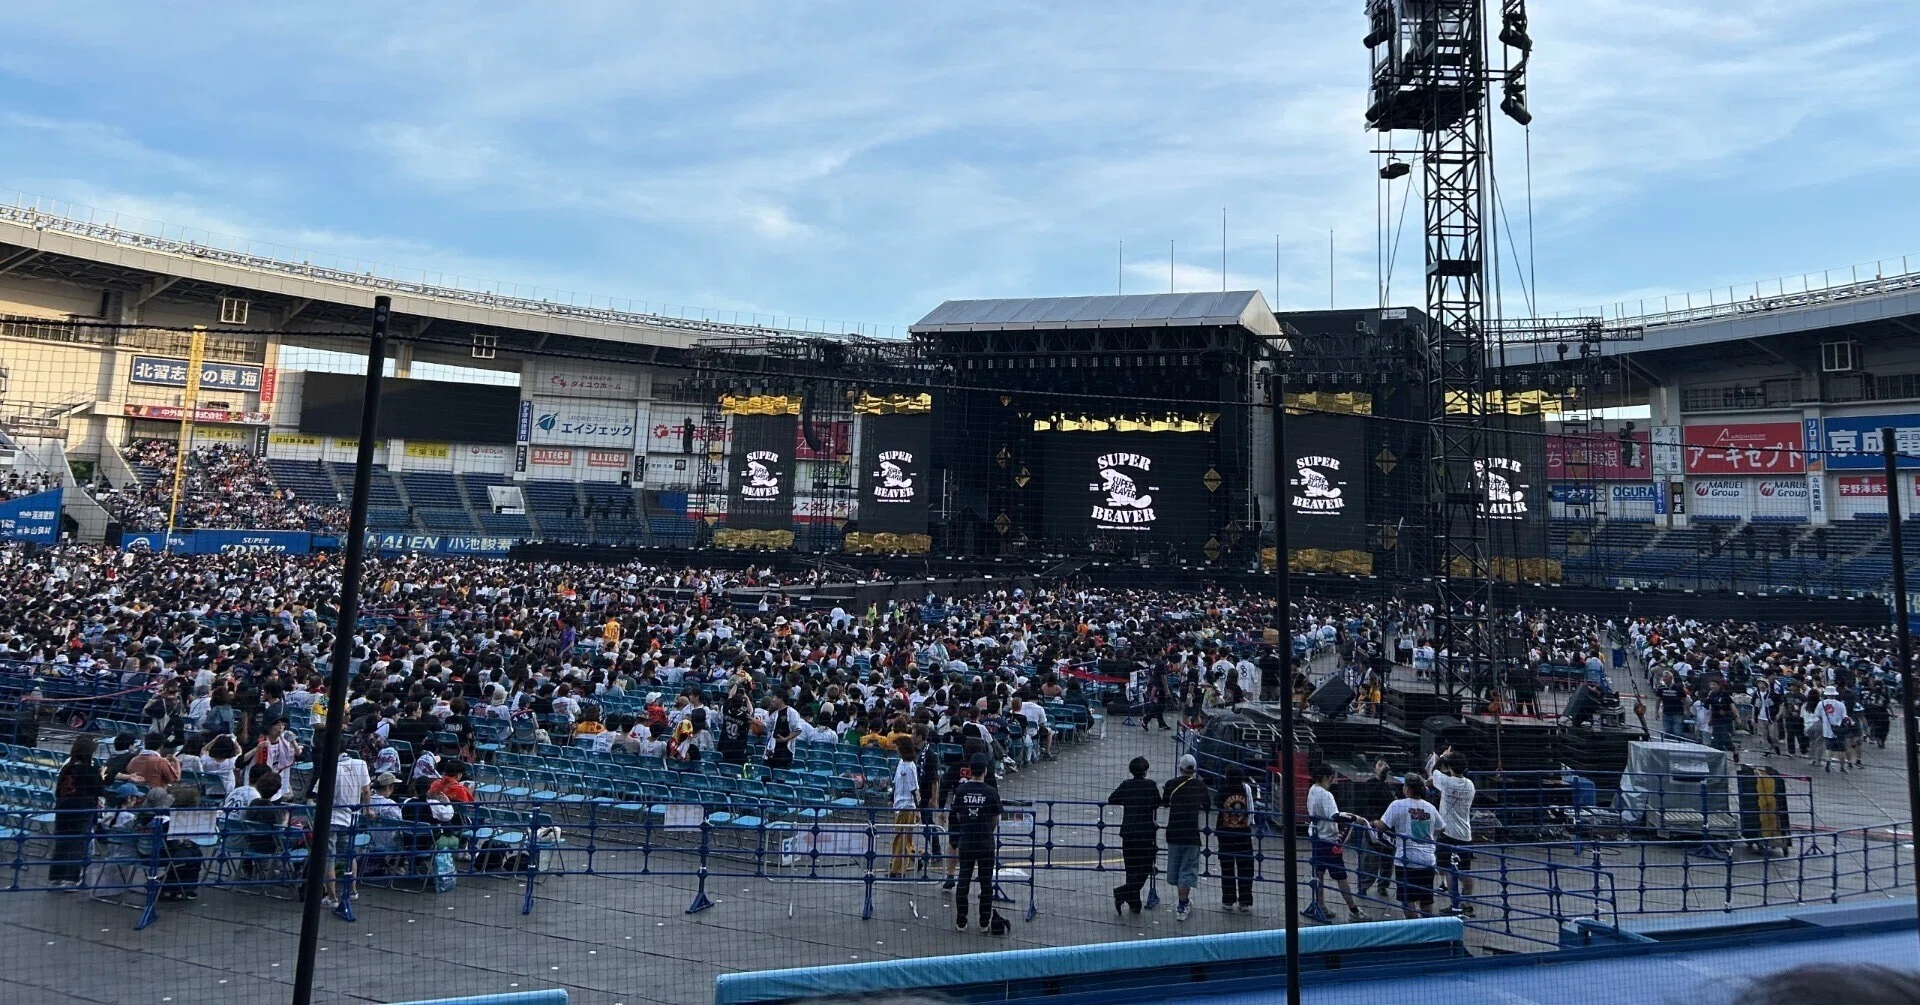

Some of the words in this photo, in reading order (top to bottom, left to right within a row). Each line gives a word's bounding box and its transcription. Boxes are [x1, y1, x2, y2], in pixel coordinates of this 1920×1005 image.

[136, 362, 258, 387] 北習志の東海
[561, 423, 632, 436] エイジェック
[746, 451, 779, 462] SUPER
[878, 451, 913, 463] SUPER
[1097, 452, 1152, 471] SUPER
[1687, 442, 1802, 469] アーキセプト
[1296, 456, 1340, 470] SUPER
[741, 485, 780, 497] BEAVER
[1709, 481, 1743, 489] MARUEI
[1775, 481, 1807, 489] MARUE
[873, 486, 915, 498] BEAVER
[1711, 490, 1740, 498] Group
[1290, 495, 1345, 509] BEAVER
[1090, 505, 1157, 523] BEAVER
[963, 795, 986, 804] STAFF
